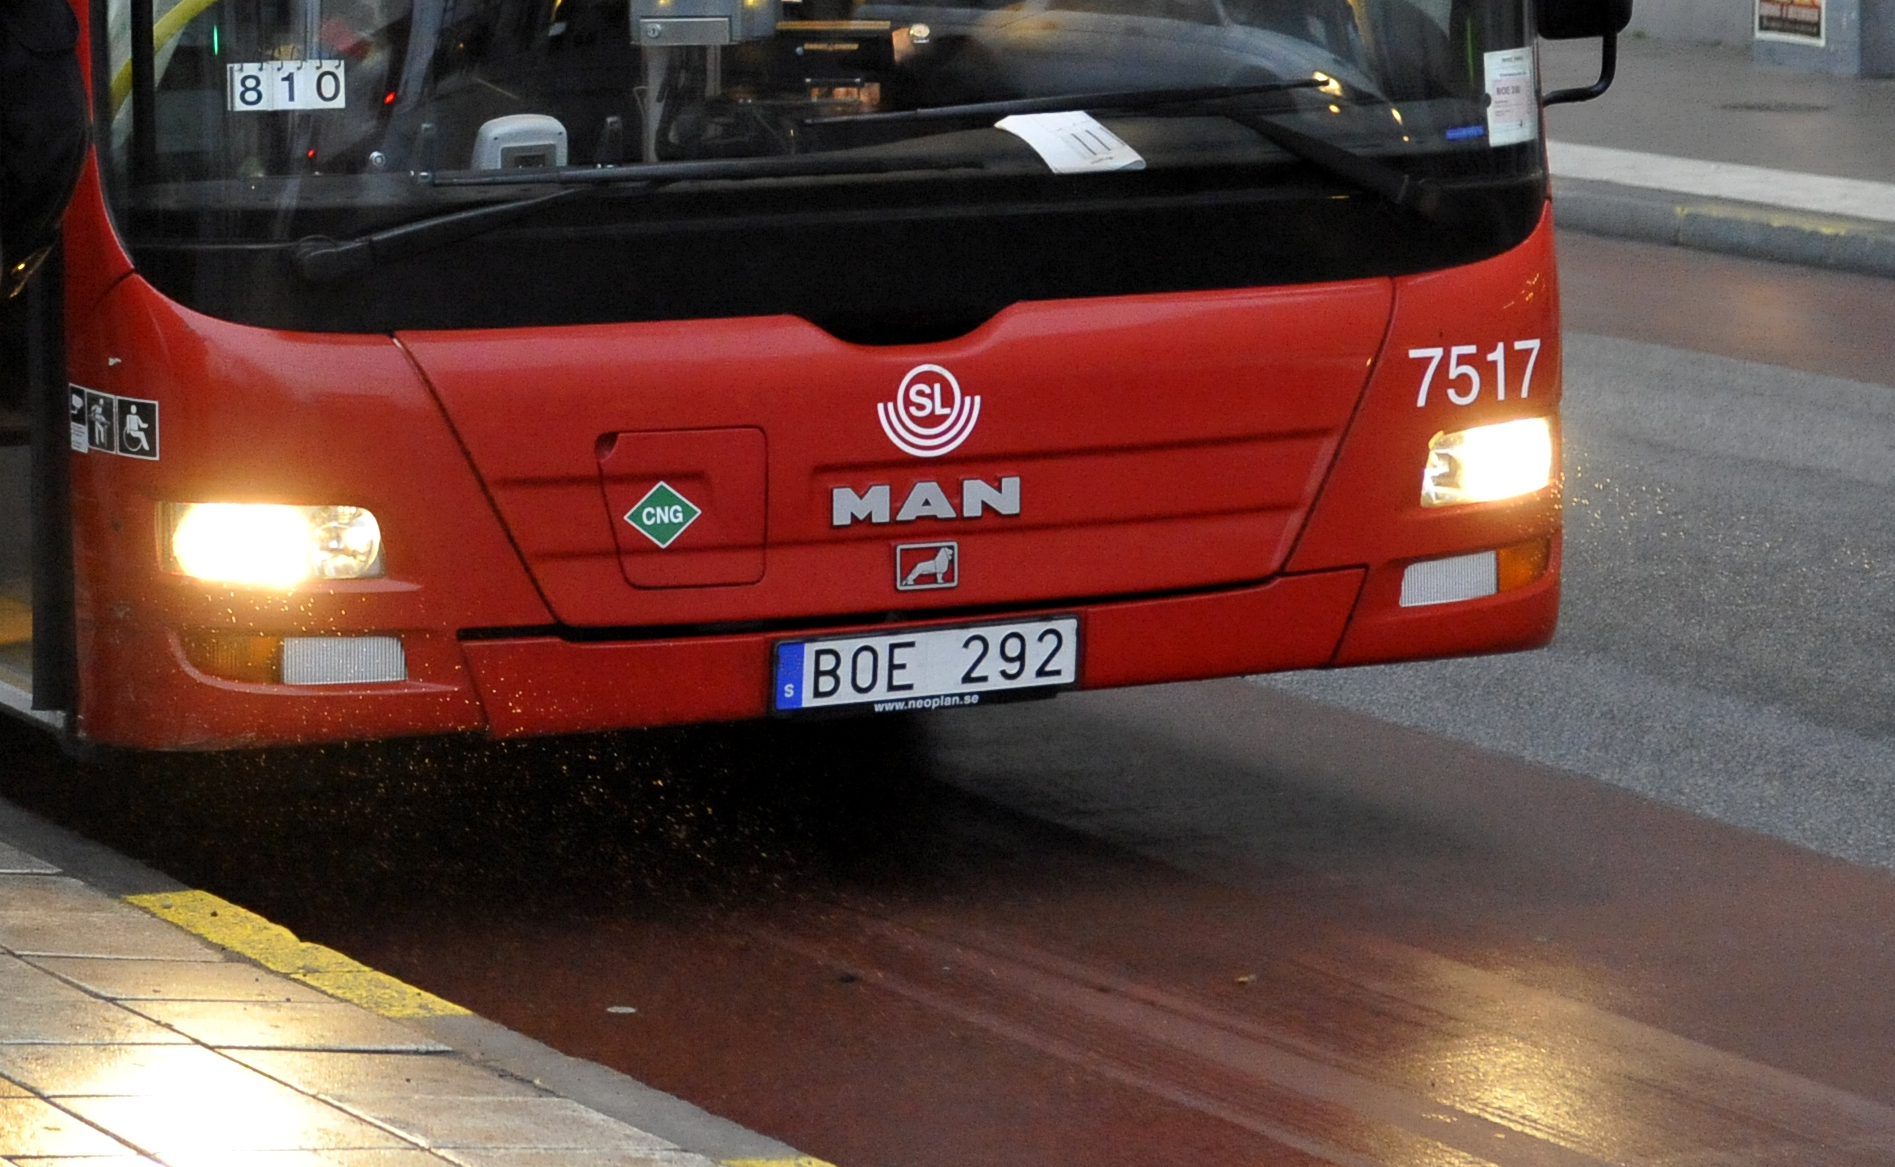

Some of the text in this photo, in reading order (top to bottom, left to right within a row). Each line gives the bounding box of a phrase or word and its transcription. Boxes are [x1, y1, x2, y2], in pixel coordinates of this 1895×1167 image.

[239, 70, 341, 106] 810
[1408, 338, 1541, 408] 7517
[909, 382, 952, 417] SL
[642, 504, 684, 526] CNG
[831, 476, 1021, 527] MAN
[812, 628, 1064, 699] BOE 292
[784, 684, 795, 699] S
[874, 693, 980, 713] www.neoplan.se
